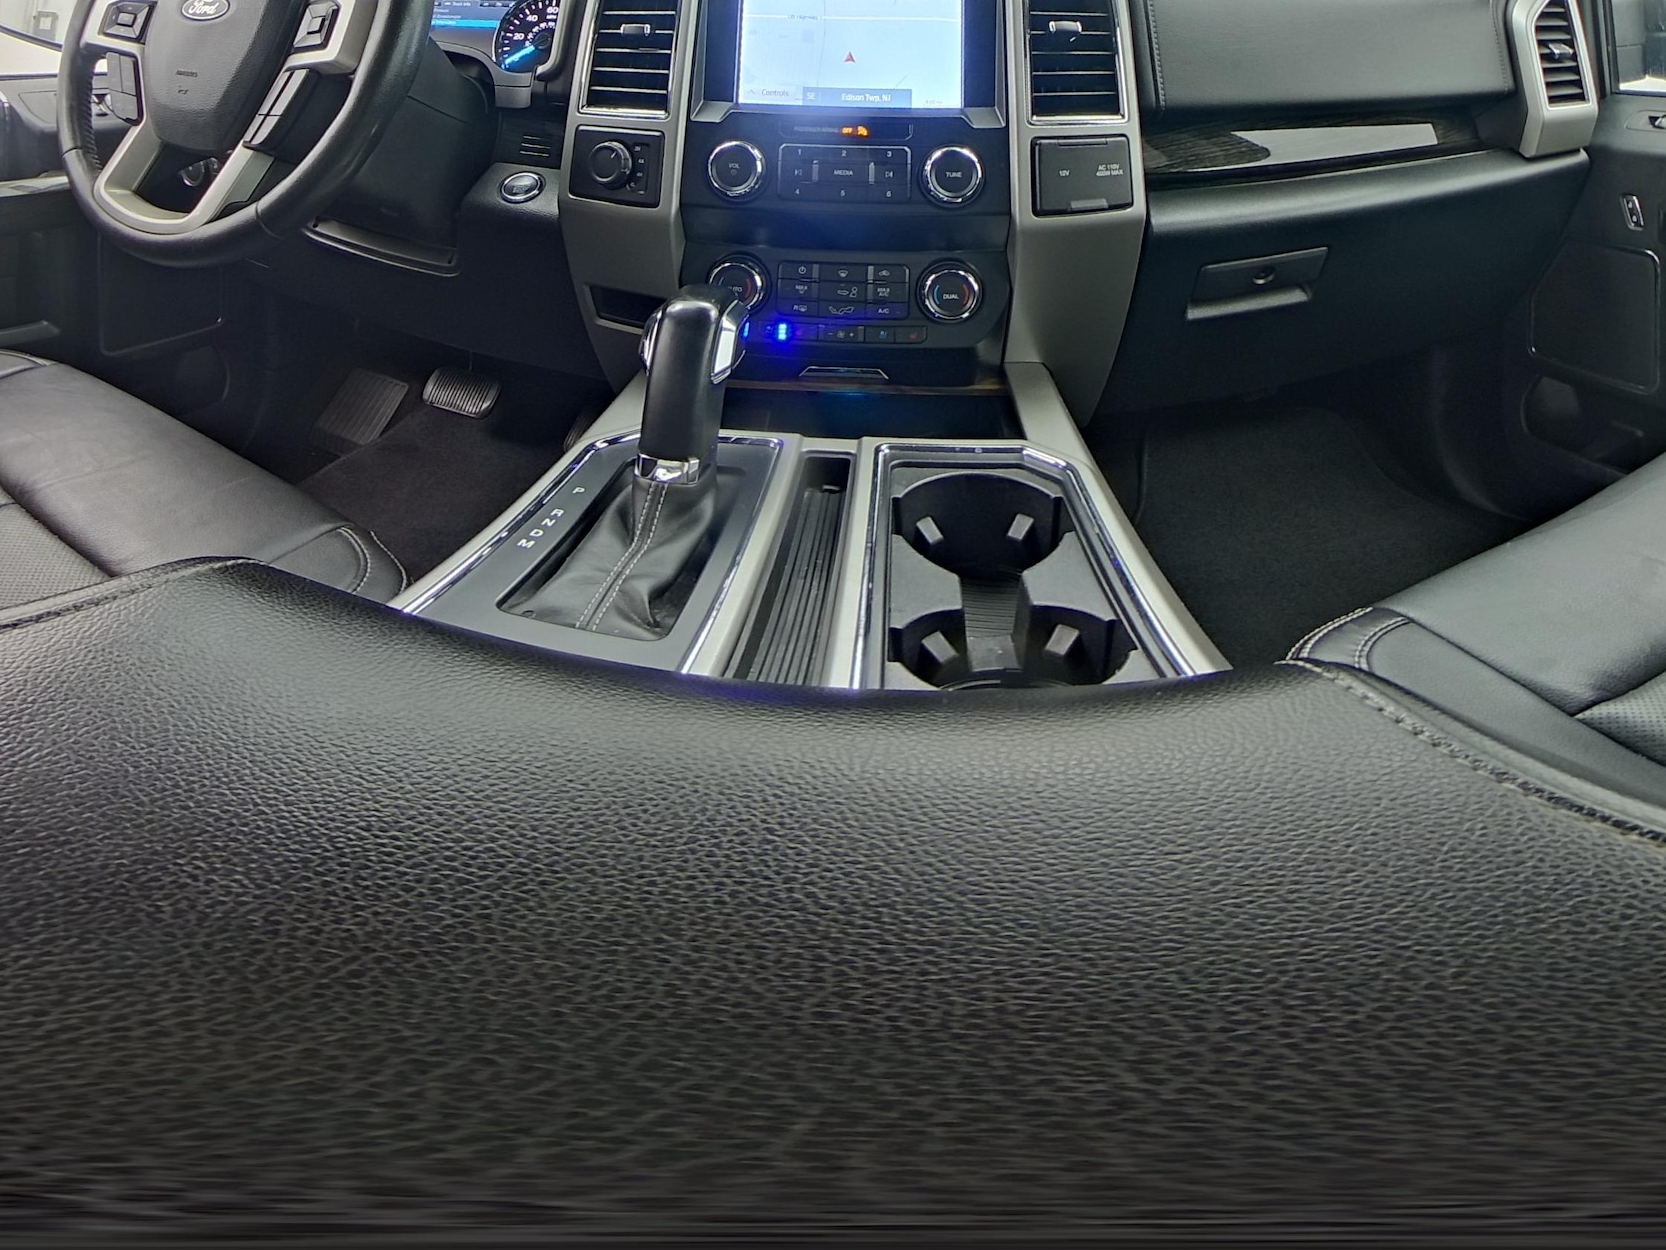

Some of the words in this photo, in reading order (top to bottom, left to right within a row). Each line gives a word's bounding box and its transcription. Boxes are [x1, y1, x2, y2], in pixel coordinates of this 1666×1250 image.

[546, 6, 559, 14] 60
[526, 14, 539, 22] 40
[513, 32, 525, 40] 20
[761, 88, 789, 98] Controls
[806, 92, 816, 100] SE
[841, 93, 864, 101] Edison
[833, 169, 854, 177] MEDIA
[945, 171, 963, 179] TUNE
[1058, 169, 1070, 177] 12V
[572, 486, 586, 494] P
[550, 508, 565, 517] R
[541, 518, 556, 527] N
[529, 528, 544, 537] D
[517, 538, 536, 549] M
